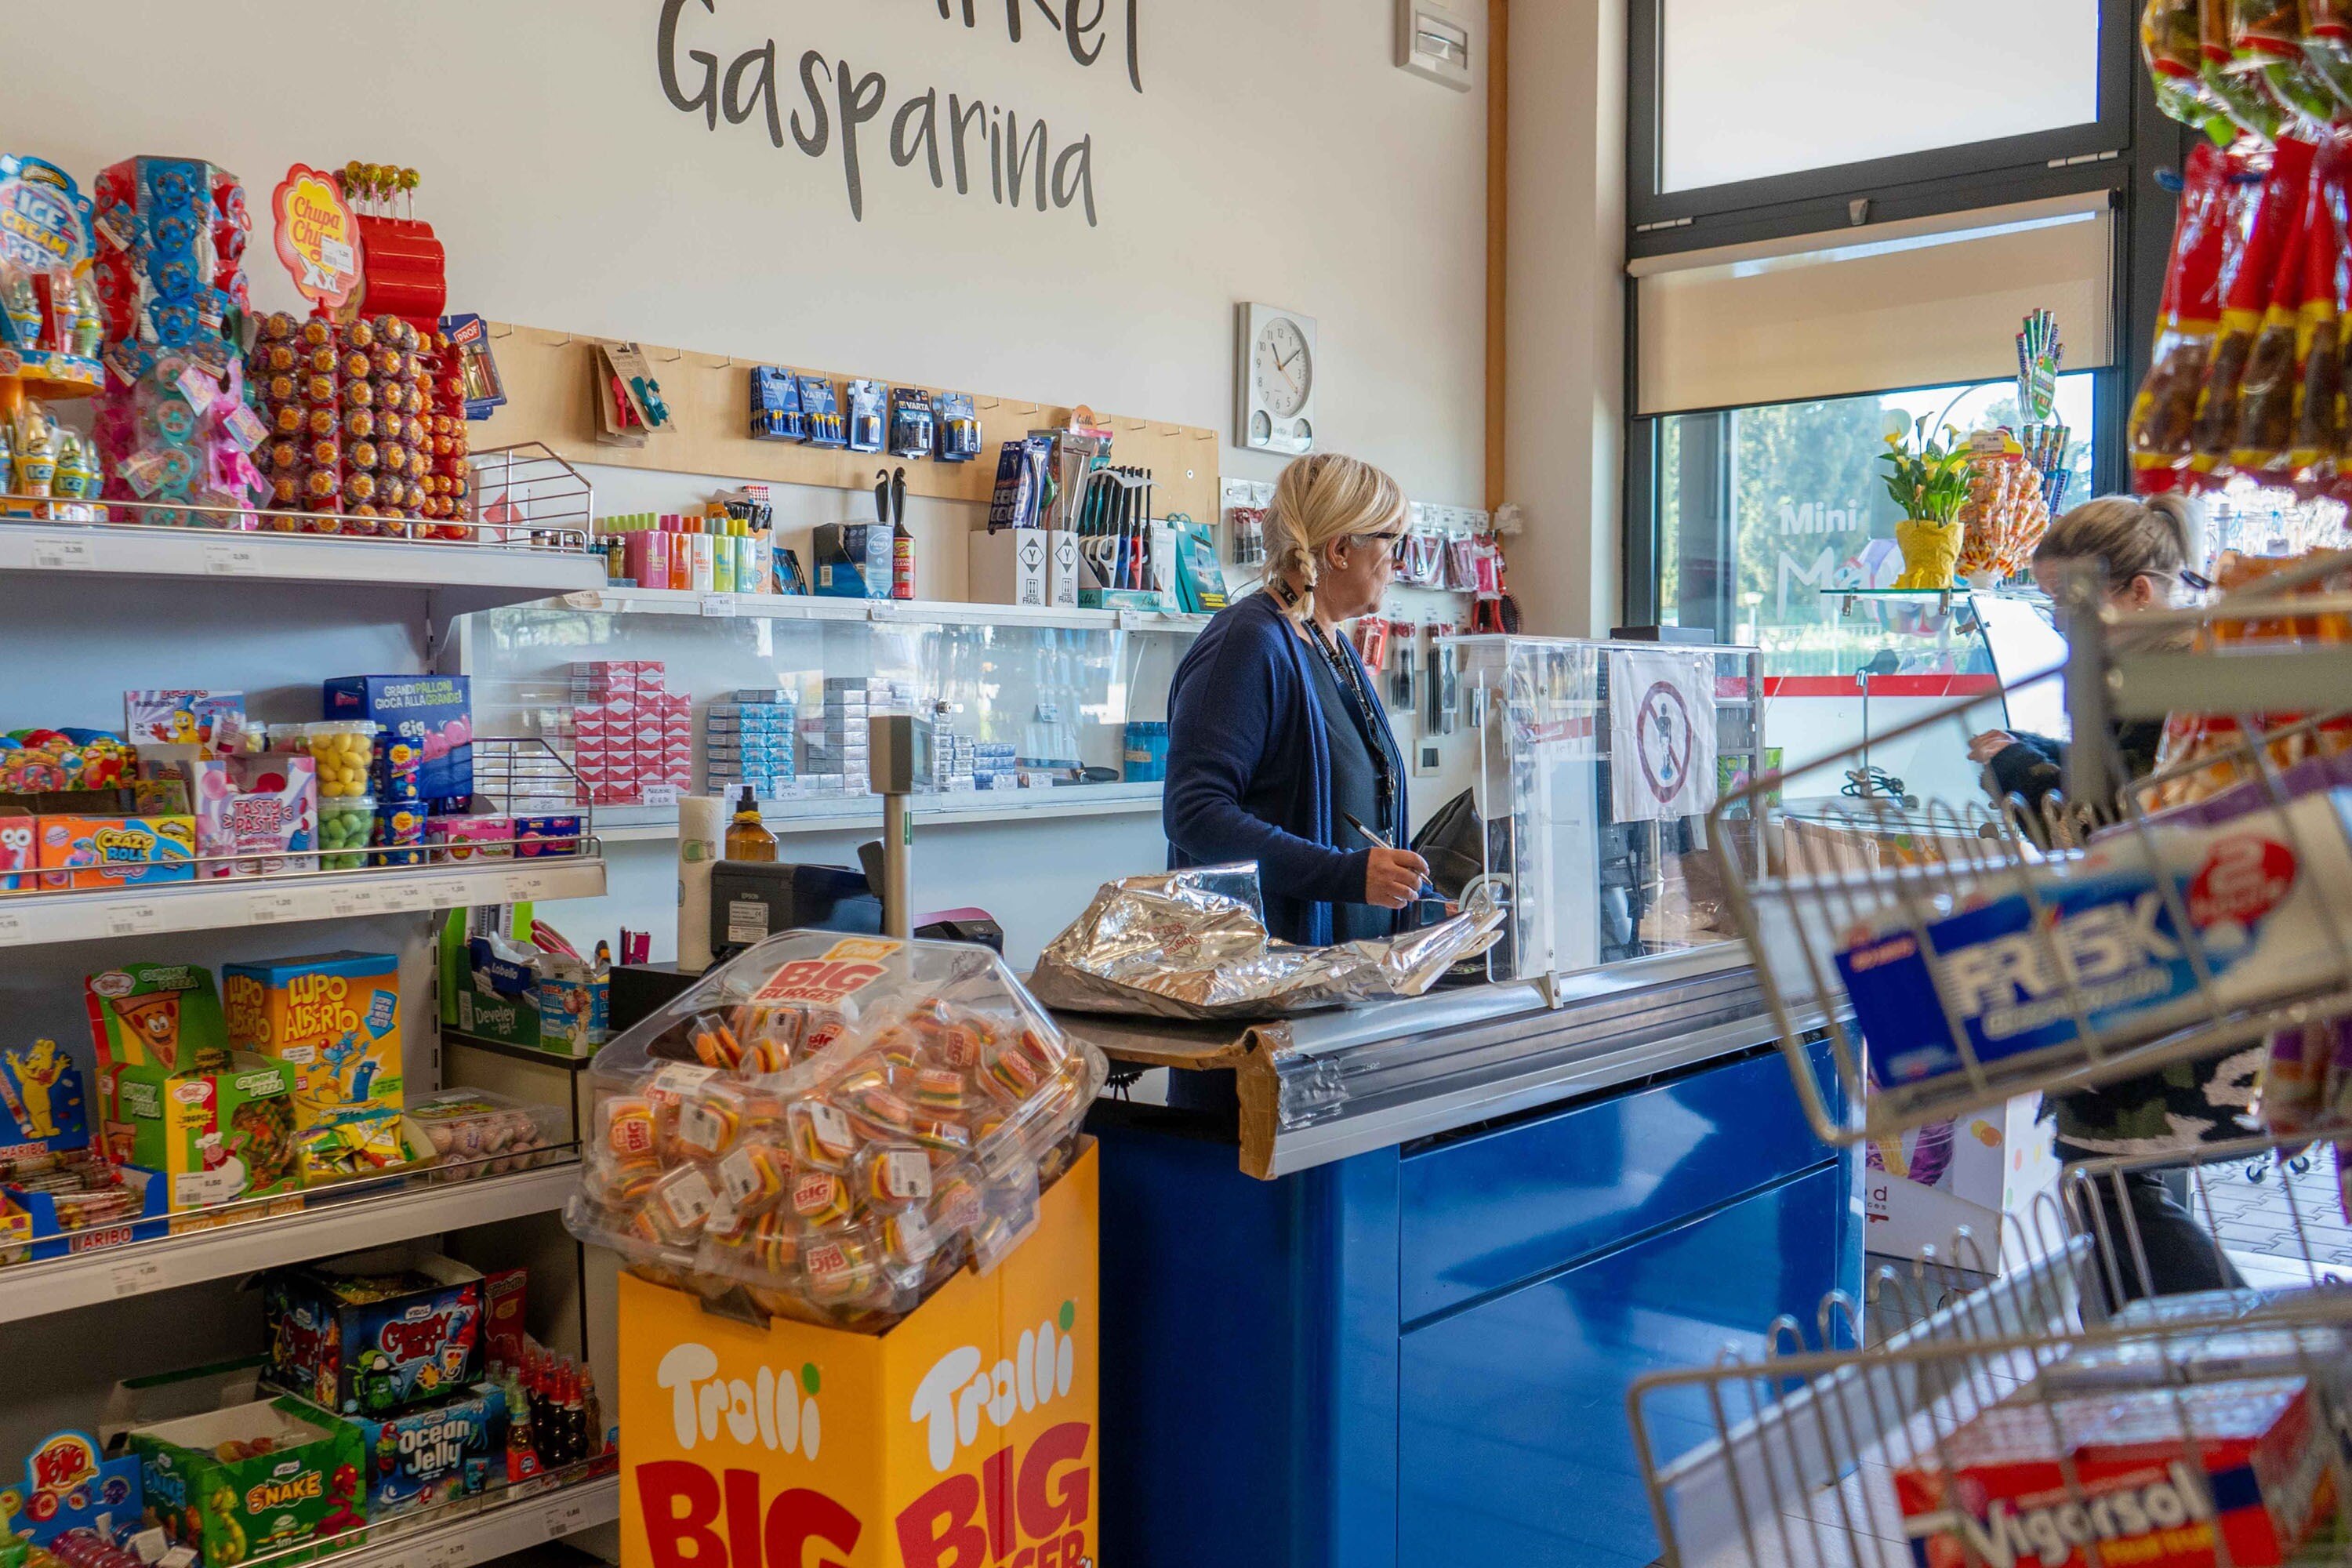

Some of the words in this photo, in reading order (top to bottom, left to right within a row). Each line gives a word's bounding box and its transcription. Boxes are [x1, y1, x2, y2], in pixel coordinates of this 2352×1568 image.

[657, 0, 1098, 223] Gasparina
[18, 189, 65, 230] ICE
[294, 196, 341, 230] Chupa
[2, 209, 70, 258] CREAM
[292, 220, 340, 245] Chu
[299, 253, 341, 293] XXL
[456, 325, 479, 343] PROF
[1268, 330, 1273, 340] 11
[1278, 328, 1283, 339] 12
[1289, 336, 1293, 347] 1
[1259, 341, 1266, 352] 10
[1256, 358, 1261, 368] 9
[2016, 340, 2027, 376] mentos
[1258, 377, 1262, 387] 8
[1298, 368, 1301, 379] 3
[763, 380, 796, 392] VARTA
[802, 391, 834, 401] VARTA
[1265, 391, 1270, 401] 7
[1276, 399, 1280, 409] 6
[1287, 397, 1291, 408] 5
[906, 402, 930, 412] VARTA
[1780, 499, 1858, 535] Mini
[1029, 550, 1036, 562] Y
[1064, 549, 1071, 562] Y
[384, 684, 416, 697] GRANDI
[416, 681, 453, 693] PALLONI
[375, 696, 404, 710] GIOCA
[405, 695, 426, 707] ALLA
[426, 689, 463, 705] GRANDE!
[398, 719, 426, 738] Big
[234, 800, 282, 816] TASTY
[235, 816, 282, 837] PASTE
[101, 833, 153, 849] CRAZY
[107, 847, 147, 862] ROLL
[491, 961, 519, 980] Labello
[770, 962, 884, 992] BIG
[228, 975, 263, 1007] LUPO
[289, 972, 348, 1007] LUPO
[755, 987, 846, 1004] BURGER
[283, 1000, 359, 1043] ALBERTO
[474, 1007, 517, 1025] Develey
[235, 1070, 280, 1090] GUMMY
[250, 1079, 285, 1098] PIZZA
[627, 1121, 642, 1152] BIG
[0, 1142, 48, 1158] HARIBO
[796, 1183, 829, 1203] BIG
[809, 1254, 847, 1274] BIG
[910, 1300, 1076, 1472] Trolli
[657, 1342, 821, 1461] Trolli
[398, 1419, 470, 1452] Ocean
[405, 1441, 463, 1475] Jelly
[247, 1471, 321, 1514] SNAKE
[895, 1421, 1091, 1568] BIG
[636, 1460, 862, 1568] BIG
[1962, 1461, 2211, 1568] Vigorsol
